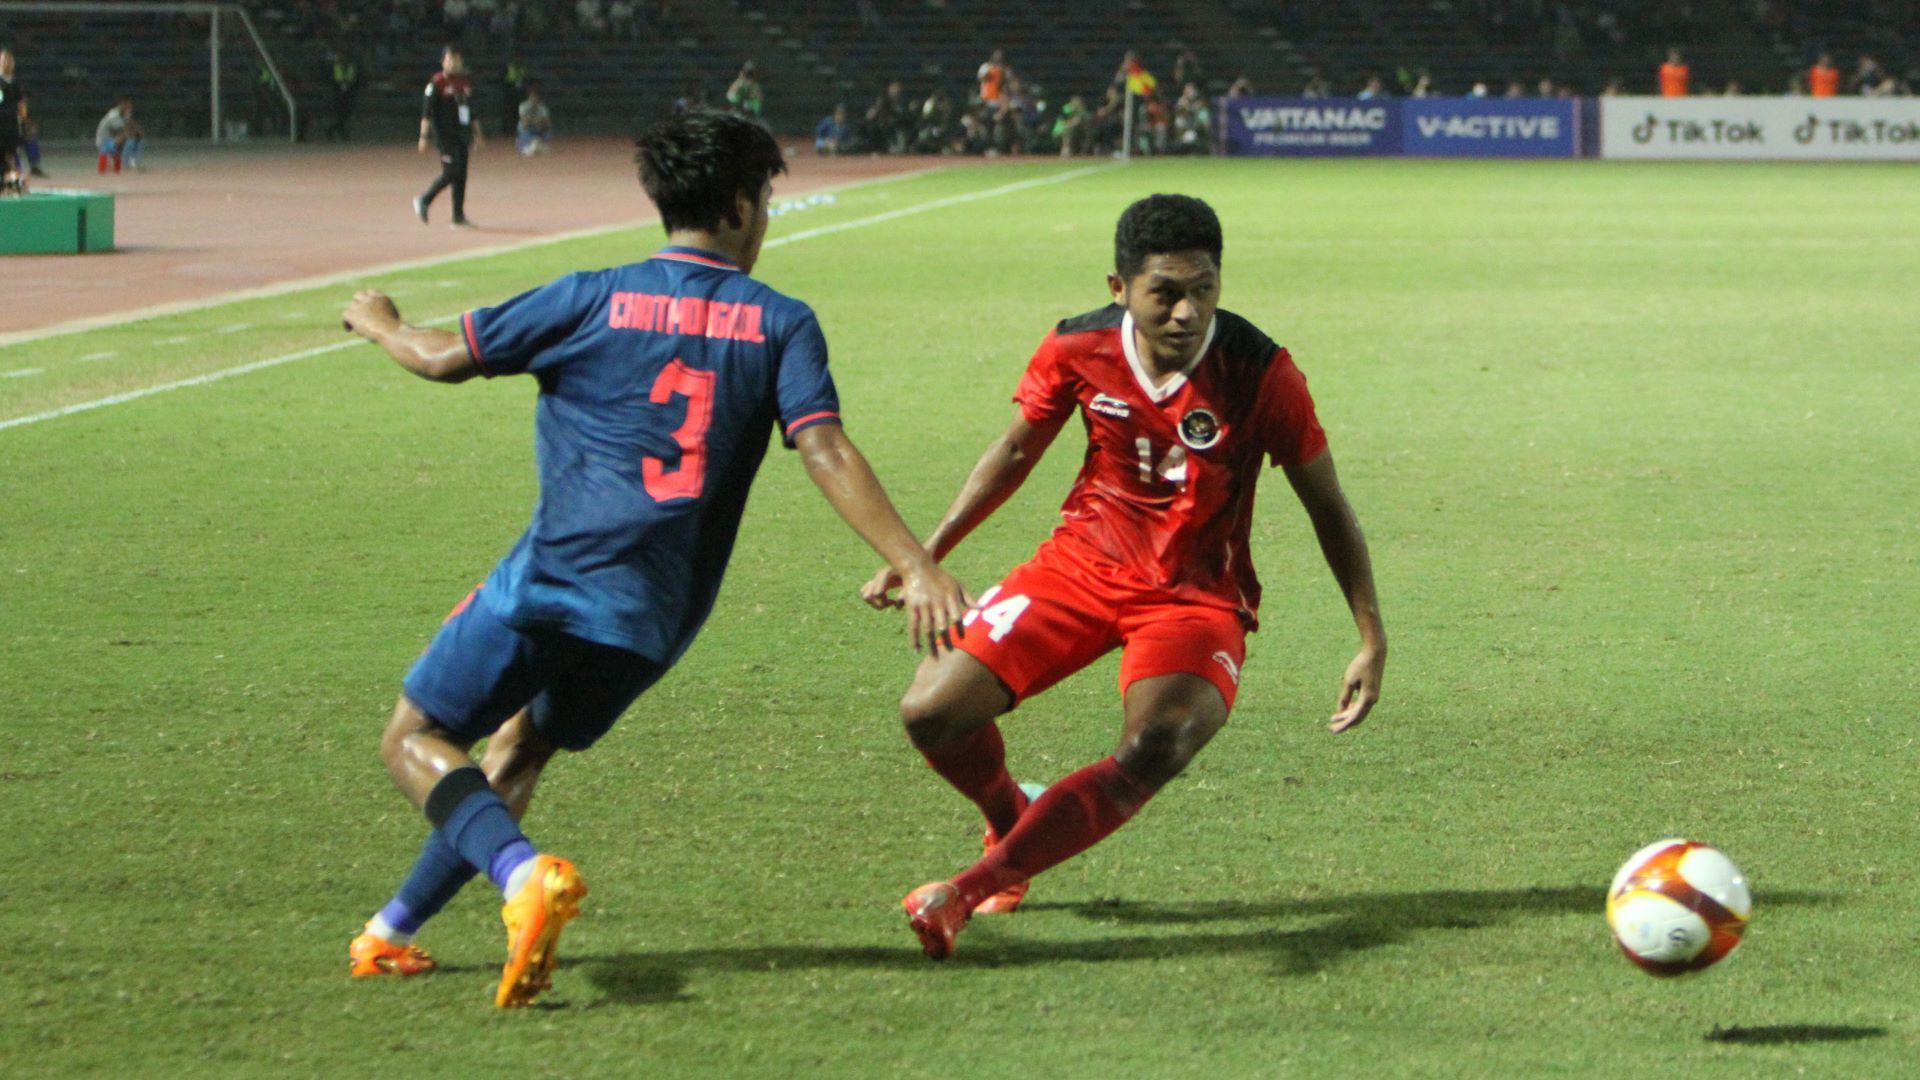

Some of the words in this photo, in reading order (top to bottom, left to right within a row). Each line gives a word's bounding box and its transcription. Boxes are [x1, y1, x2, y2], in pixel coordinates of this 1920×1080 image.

[1241, 108, 1386, 130] VATTANAC
[1666, 119, 1764, 143] TikTok
[641, 357, 717, 503] 3
[1135, 437, 1187, 494] 14
